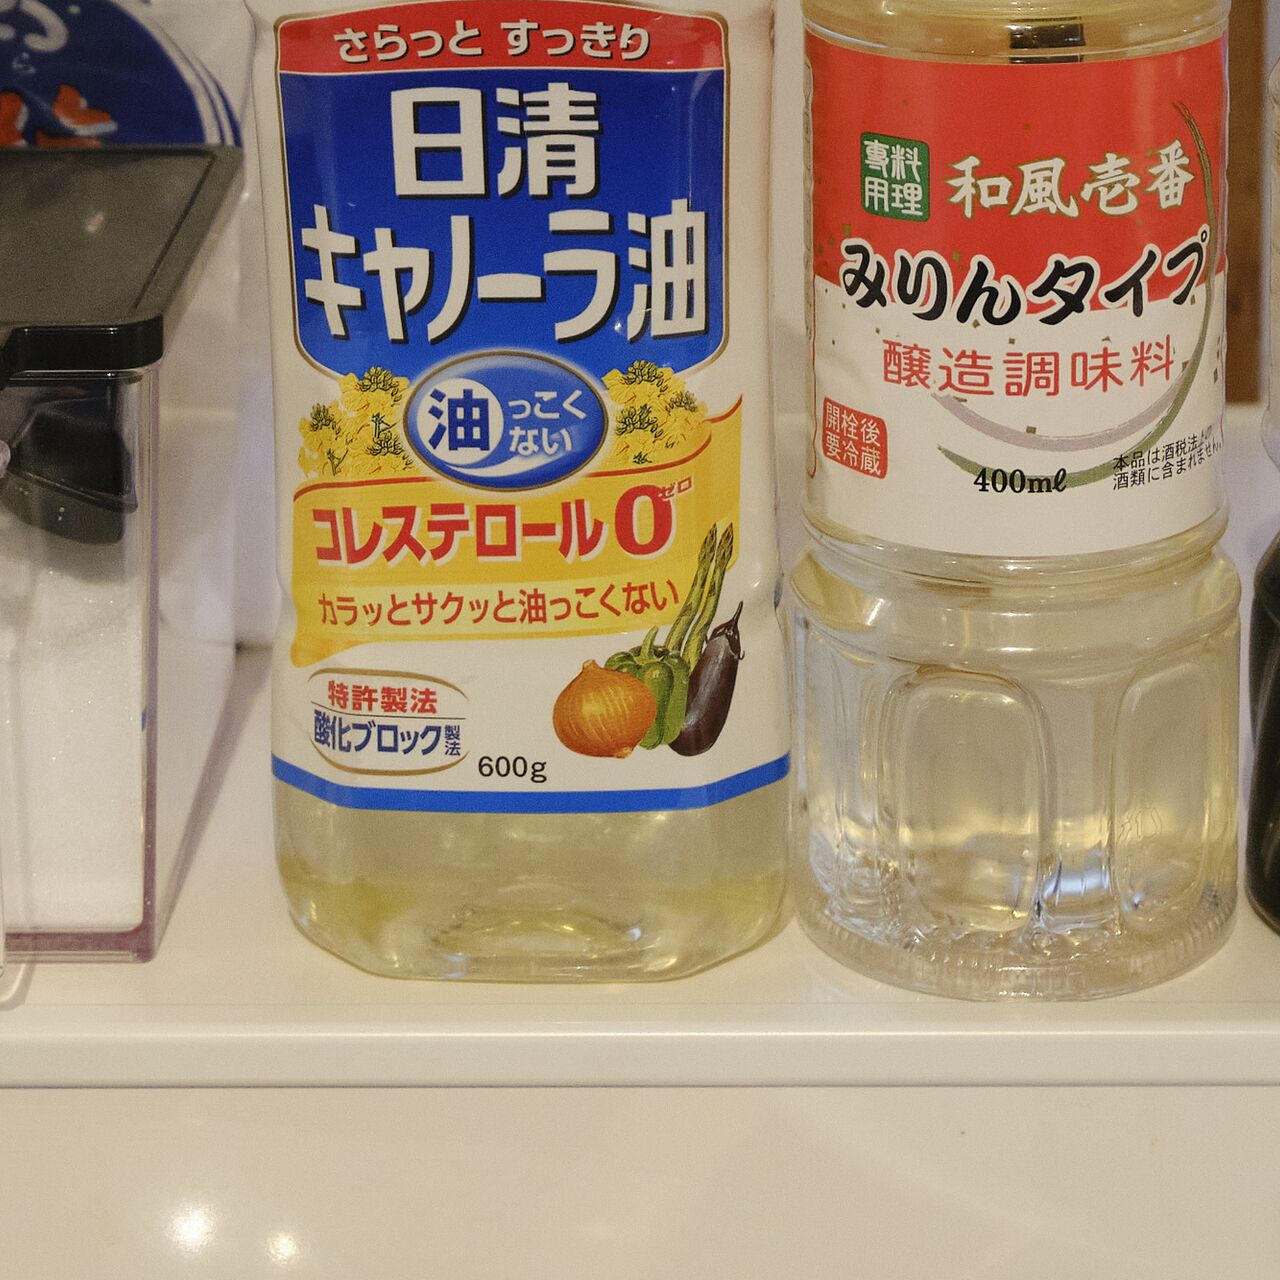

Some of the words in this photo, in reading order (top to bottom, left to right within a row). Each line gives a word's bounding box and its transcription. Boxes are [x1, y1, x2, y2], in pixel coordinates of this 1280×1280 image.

[333, 20, 483, 62] さらっと
[500, 19, 651, 61] すっきり
[390, 81, 601, 197] 日清
[947, 139, 1196, 219] 和風壱番
[301, 198, 707, 343] キャノーラ油
[842, 227, 1210, 325] みりんタイプ
[881, 334, 1174, 397] 醸造調味料
[428, 388, 491, 452] 油
[825, 401, 881, 447] 開栓後
[825, 430, 881, 476] 要冷蔵
[317, 579, 680, 627] カラッとサクッと油っこくない
[327, 680, 438, 715] 特許製法
[477, 755, 548, 784] 600g
